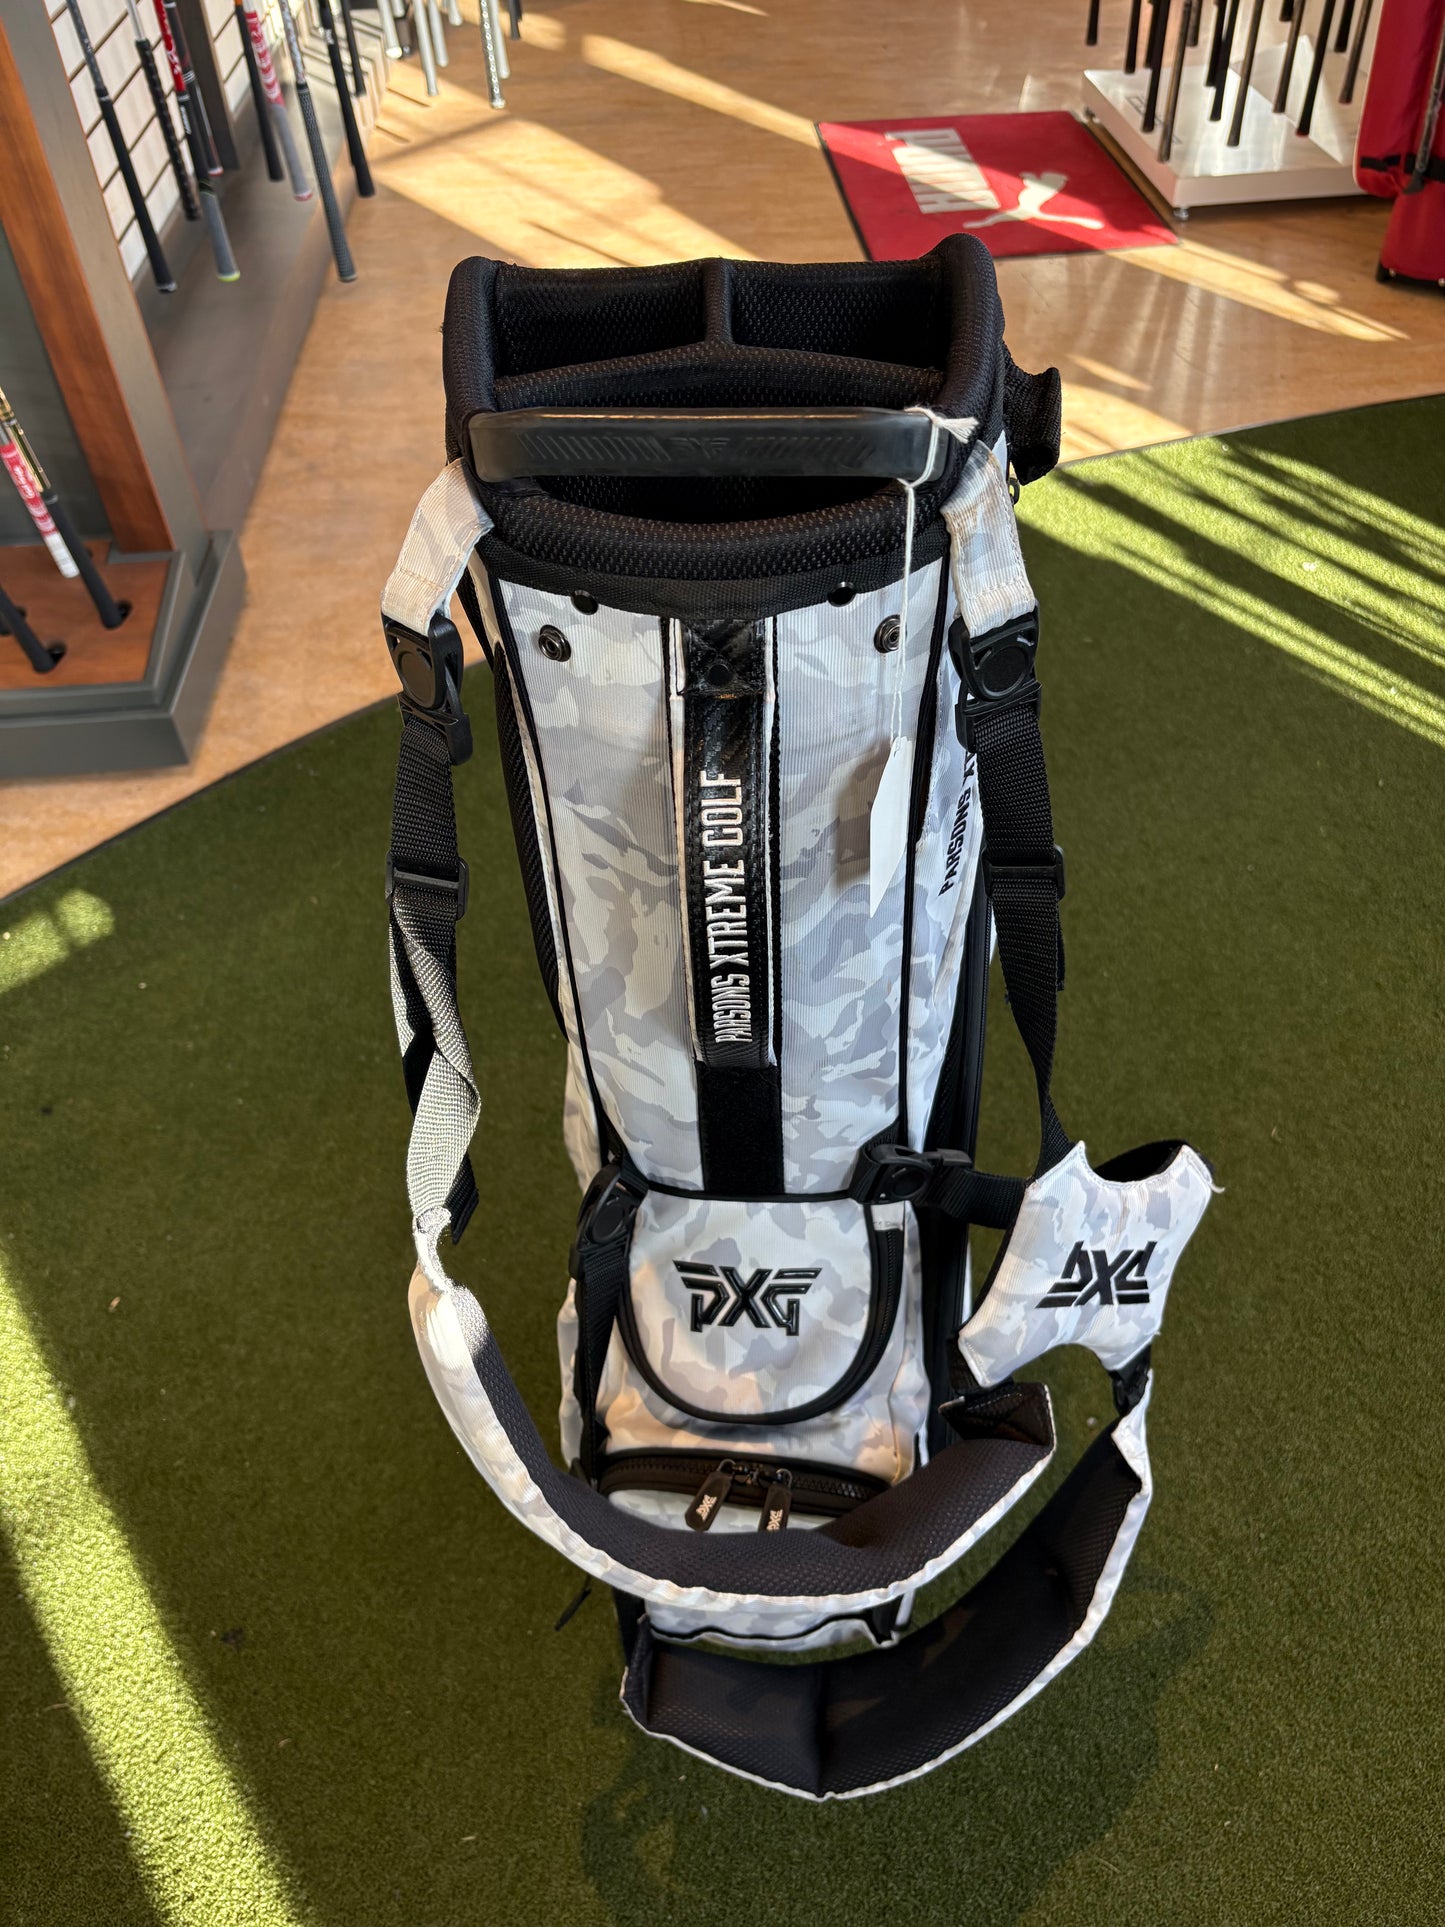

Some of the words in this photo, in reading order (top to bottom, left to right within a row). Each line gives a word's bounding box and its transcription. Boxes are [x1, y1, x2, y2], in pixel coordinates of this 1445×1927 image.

[700, 770, 744, 847] GOLF
[938, 787, 971, 896] PARSONS
[703, 859, 749, 969] XTREME
[711, 973, 753, 1043] PARSONS
[672, 1260, 823, 1337] PXG
[1034, 1240, 1158, 1309] PXG
